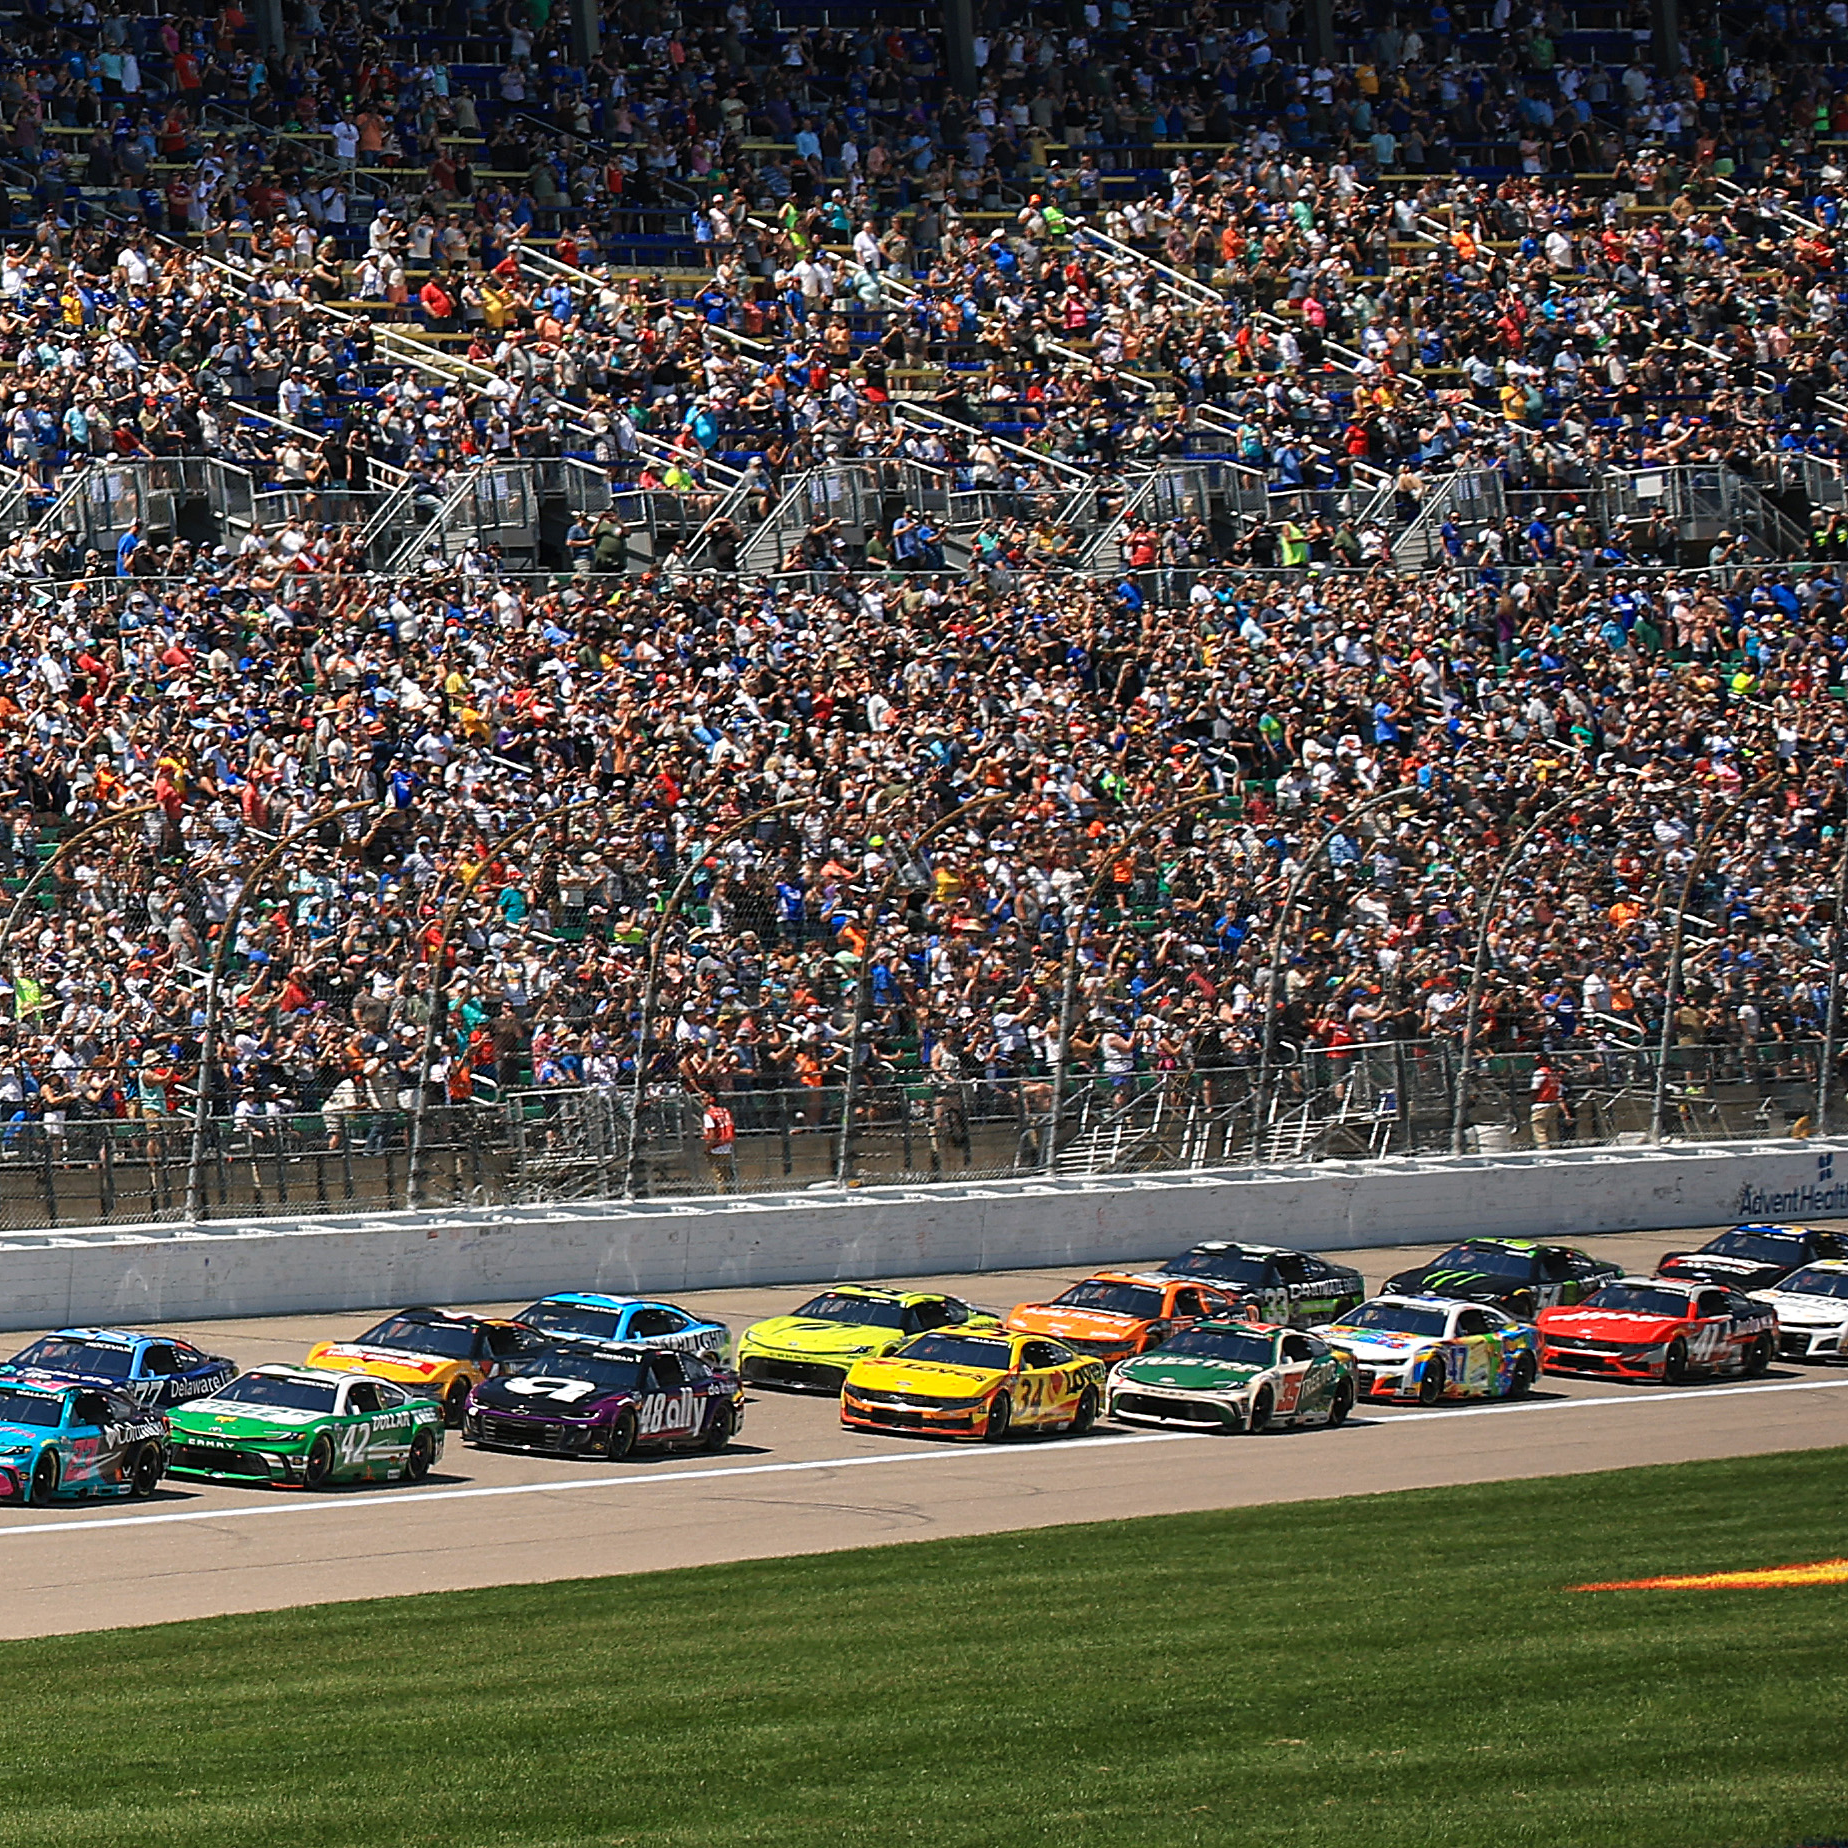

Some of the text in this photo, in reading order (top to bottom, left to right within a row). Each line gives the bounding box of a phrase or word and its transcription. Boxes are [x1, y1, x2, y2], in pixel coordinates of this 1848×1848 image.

[134, 1380, 164, 1408] 77
[170, 1375, 220, 1399] Delaware
[1016, 1374, 1045, 1416] 34
[372, 1411, 411, 1431] DOLLAR
[640, 1393, 667, 1434] 48
[666, 1386, 707, 1437] ally
[114, 1416, 164, 1445] Columbia
[188, 1438, 235, 1449] CAMRY
[341, 1423, 370, 1464] 42
